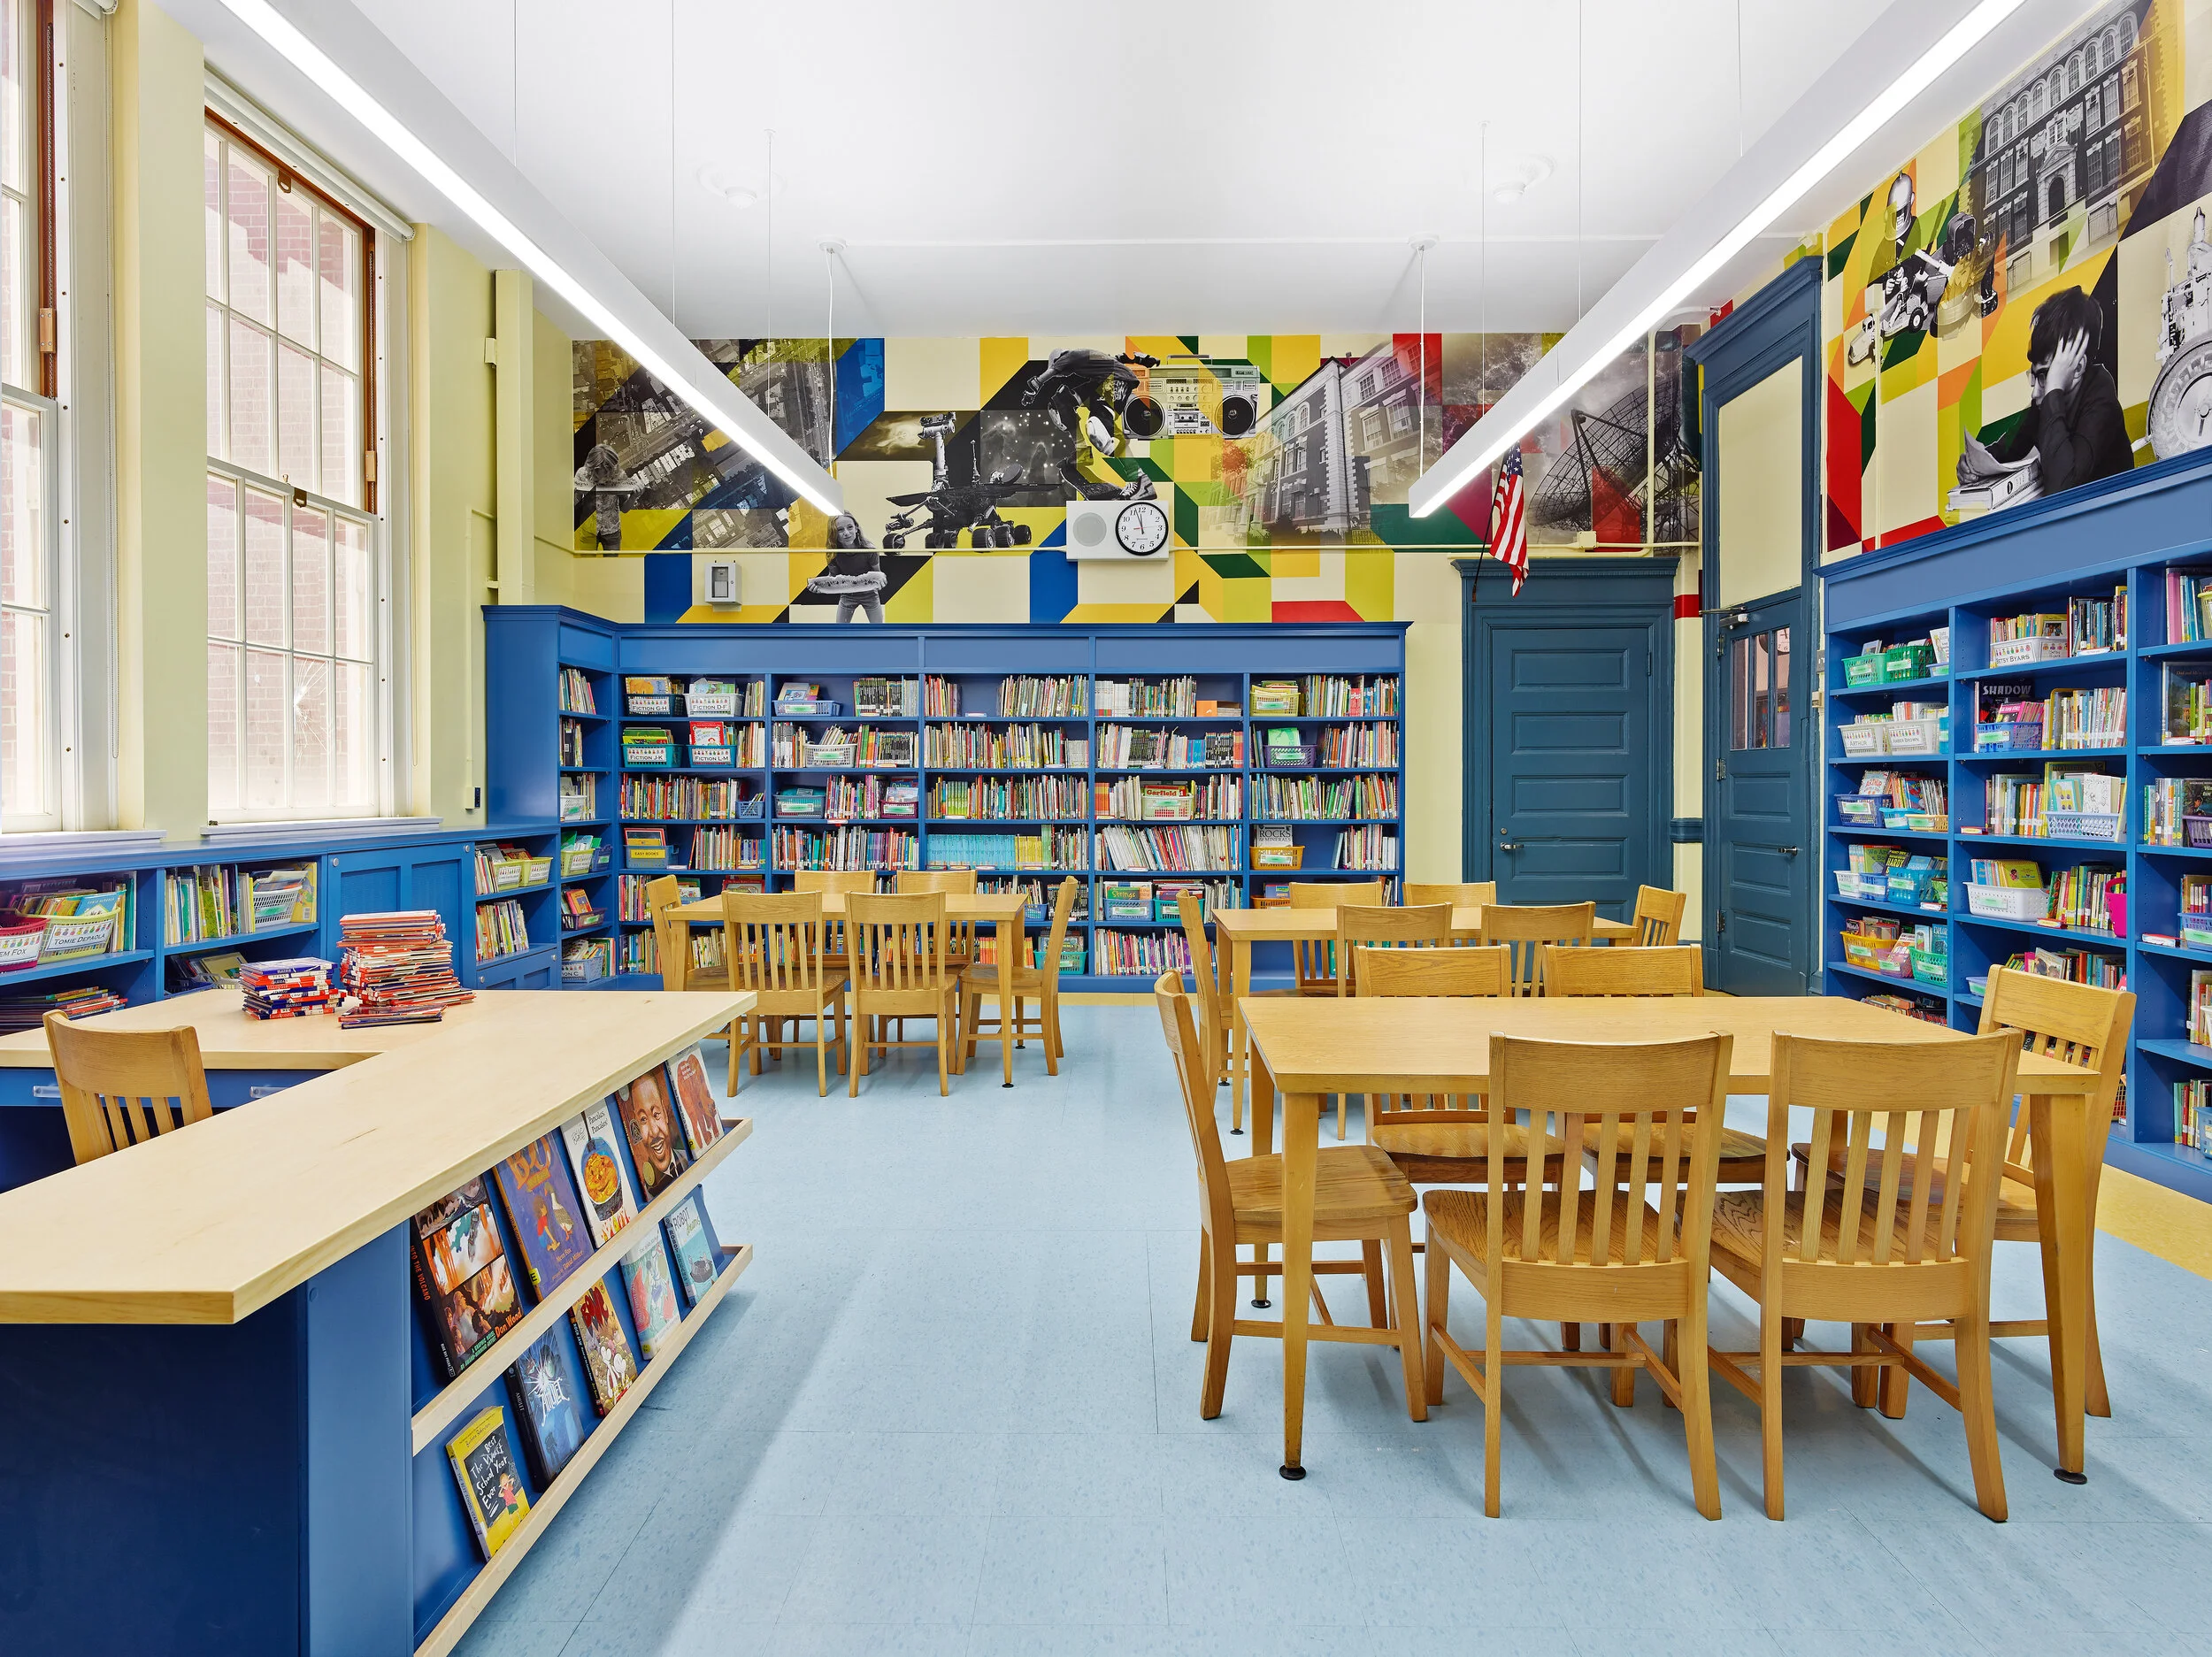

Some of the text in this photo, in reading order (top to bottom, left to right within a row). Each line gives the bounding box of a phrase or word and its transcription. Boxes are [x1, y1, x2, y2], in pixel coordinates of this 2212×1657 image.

[1983, 685, 2032, 695] SHADOW
[672, 1207, 690, 1231] ROBOT
[417, 1272, 431, 1300] VOLCANO
[580, 1286, 609, 1329] BONE
[495, 1308, 523, 1338] Don Wood
[470, 1463, 484, 1479] The
[476, 1456, 508, 1496] School Year
[481, 1486, 496, 1510] Ever
